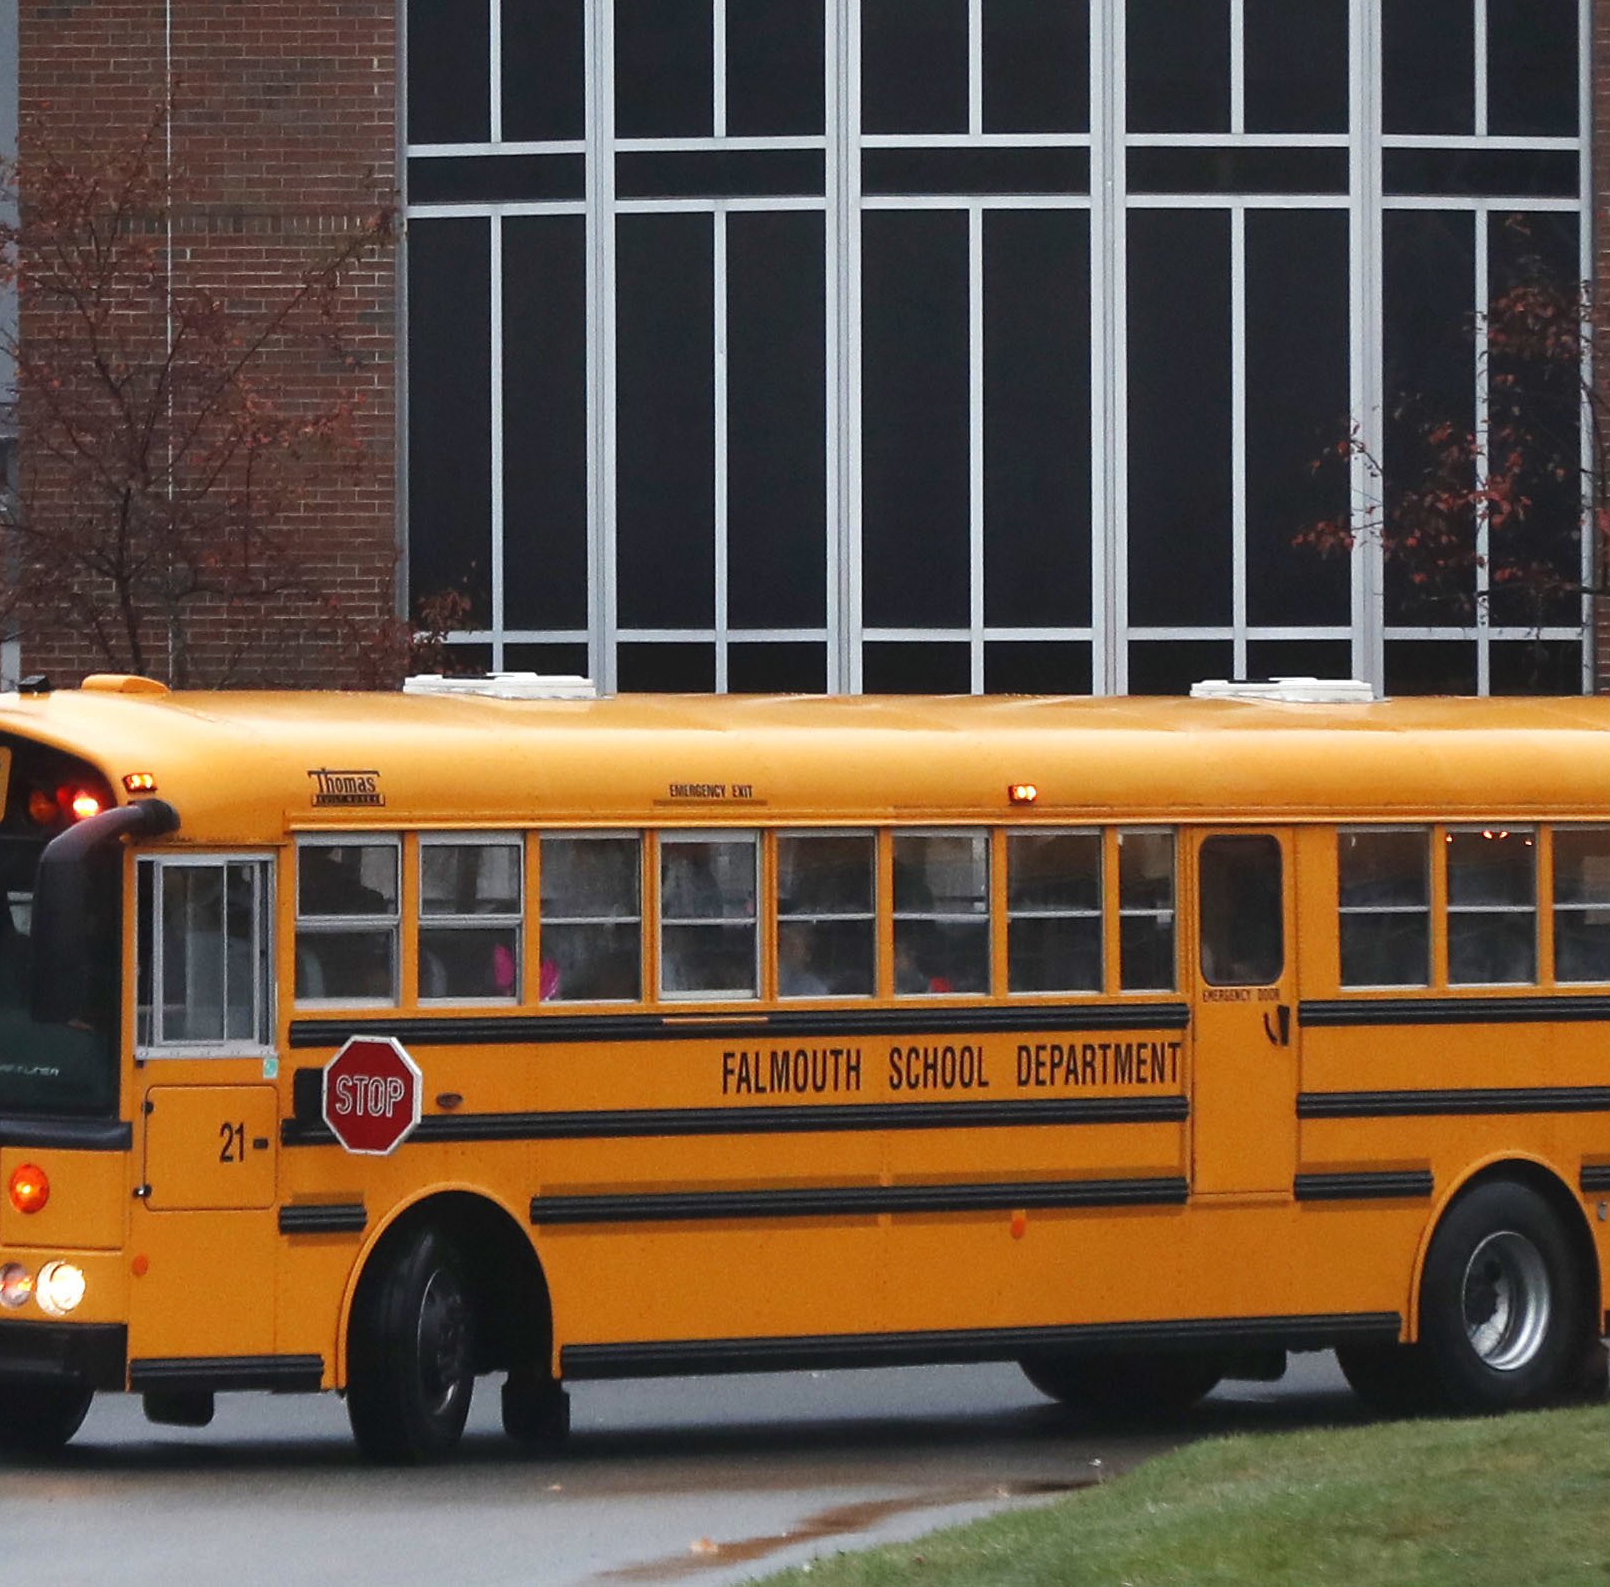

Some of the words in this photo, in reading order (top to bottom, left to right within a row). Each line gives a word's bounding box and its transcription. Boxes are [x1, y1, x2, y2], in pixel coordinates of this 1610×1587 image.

[307, 767, 380, 793] Thomas
[669, 784, 726, 797] EMERGENCY
[732, 784, 752, 798] EXIT
[722, 1048, 861, 1094] FALMOUTH
[889, 1045, 989, 1090] SCHOOL
[1016, 1042, 1181, 1087] DEPARTMENT
[335, 1074, 405, 1117] STOP
[219, 1121, 245, 1163] 21
